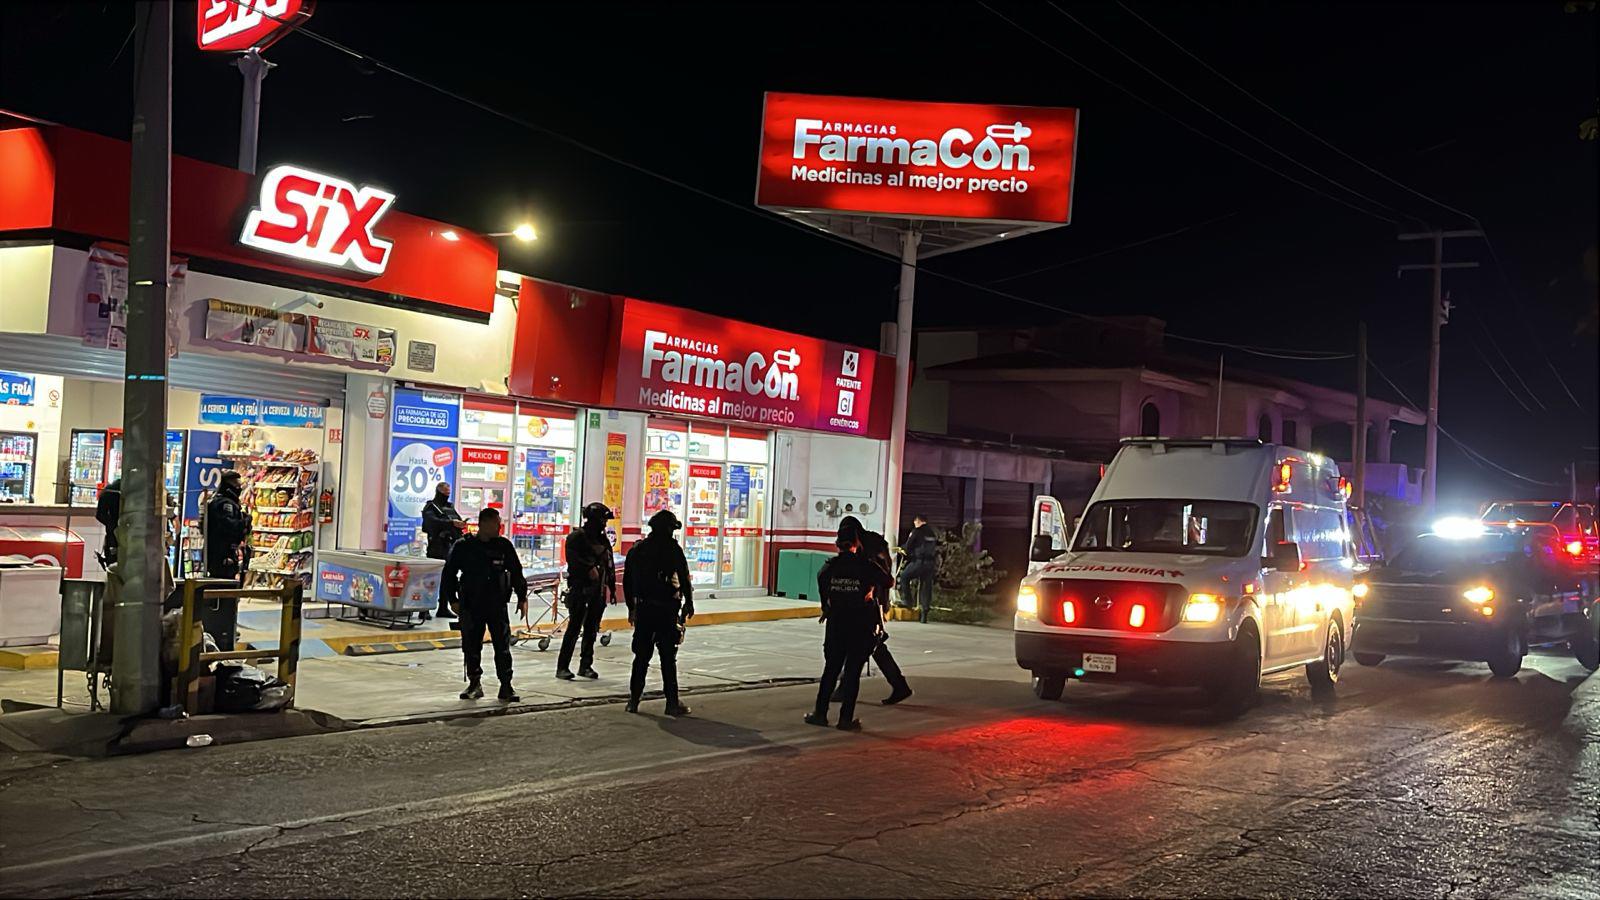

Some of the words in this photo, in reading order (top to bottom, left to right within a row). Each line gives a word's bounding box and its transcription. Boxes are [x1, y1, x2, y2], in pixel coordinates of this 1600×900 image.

[791, 166, 882, 186] Medicinas
[888, 172, 904, 187] al
[909, 175, 963, 192] mejor
[968, 175, 1028, 193] precio
[11, 381, 33, 397] FRÍA
[835, 377, 862, 390] PATENTE
[201, 404, 208, 414] LA
[208, 404, 228, 414] CERVEZA
[231, 402, 244, 416] MÁS
[245, 403, 258, 416] FRÍA
[261, 405, 268, 415] LA
[269, 406, 290, 416] CERVEZA
[293, 404, 307, 417] MÁS
[639, 387, 706, 413] Medicinas
[708, 396, 719, 414] al
[722, 401, 757, 420] mejor
[759, 407, 795, 424] precio
[405, 409, 429, 417] FARMACIA
[398, 415, 425, 424] PRECIOS
[425, 417, 446, 426] BAJOS
[408, 457, 428, 465] Hasta
[468, 451, 492, 460] MEXICO
[393, 465, 442, 493] 30%
[395, 495, 404, 503] de
